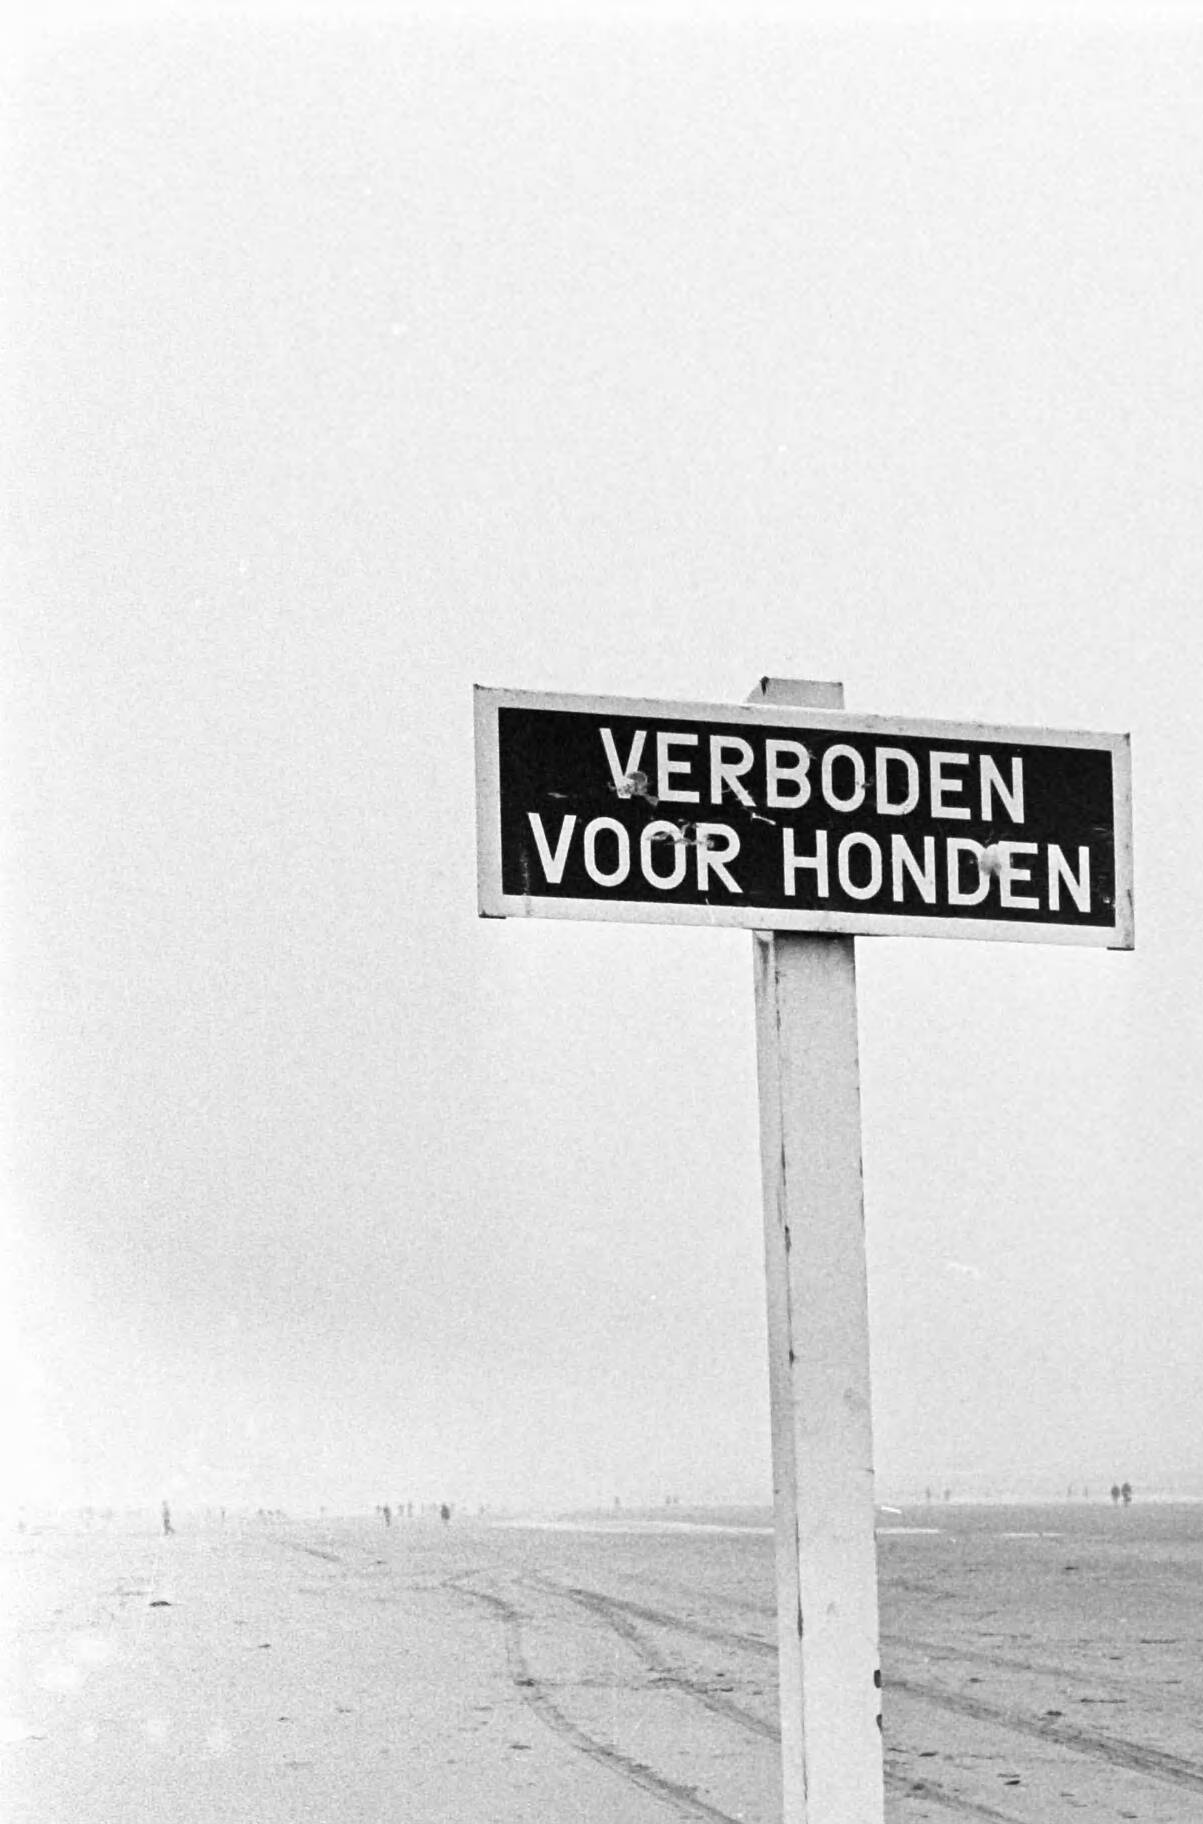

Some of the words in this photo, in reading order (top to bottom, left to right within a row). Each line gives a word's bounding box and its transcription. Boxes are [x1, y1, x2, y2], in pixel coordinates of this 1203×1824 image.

[600, 728, 1025, 824] VERBODEN
[528, 813, 744, 894] VOOR
[782, 828, 1091, 913] HONDEN
